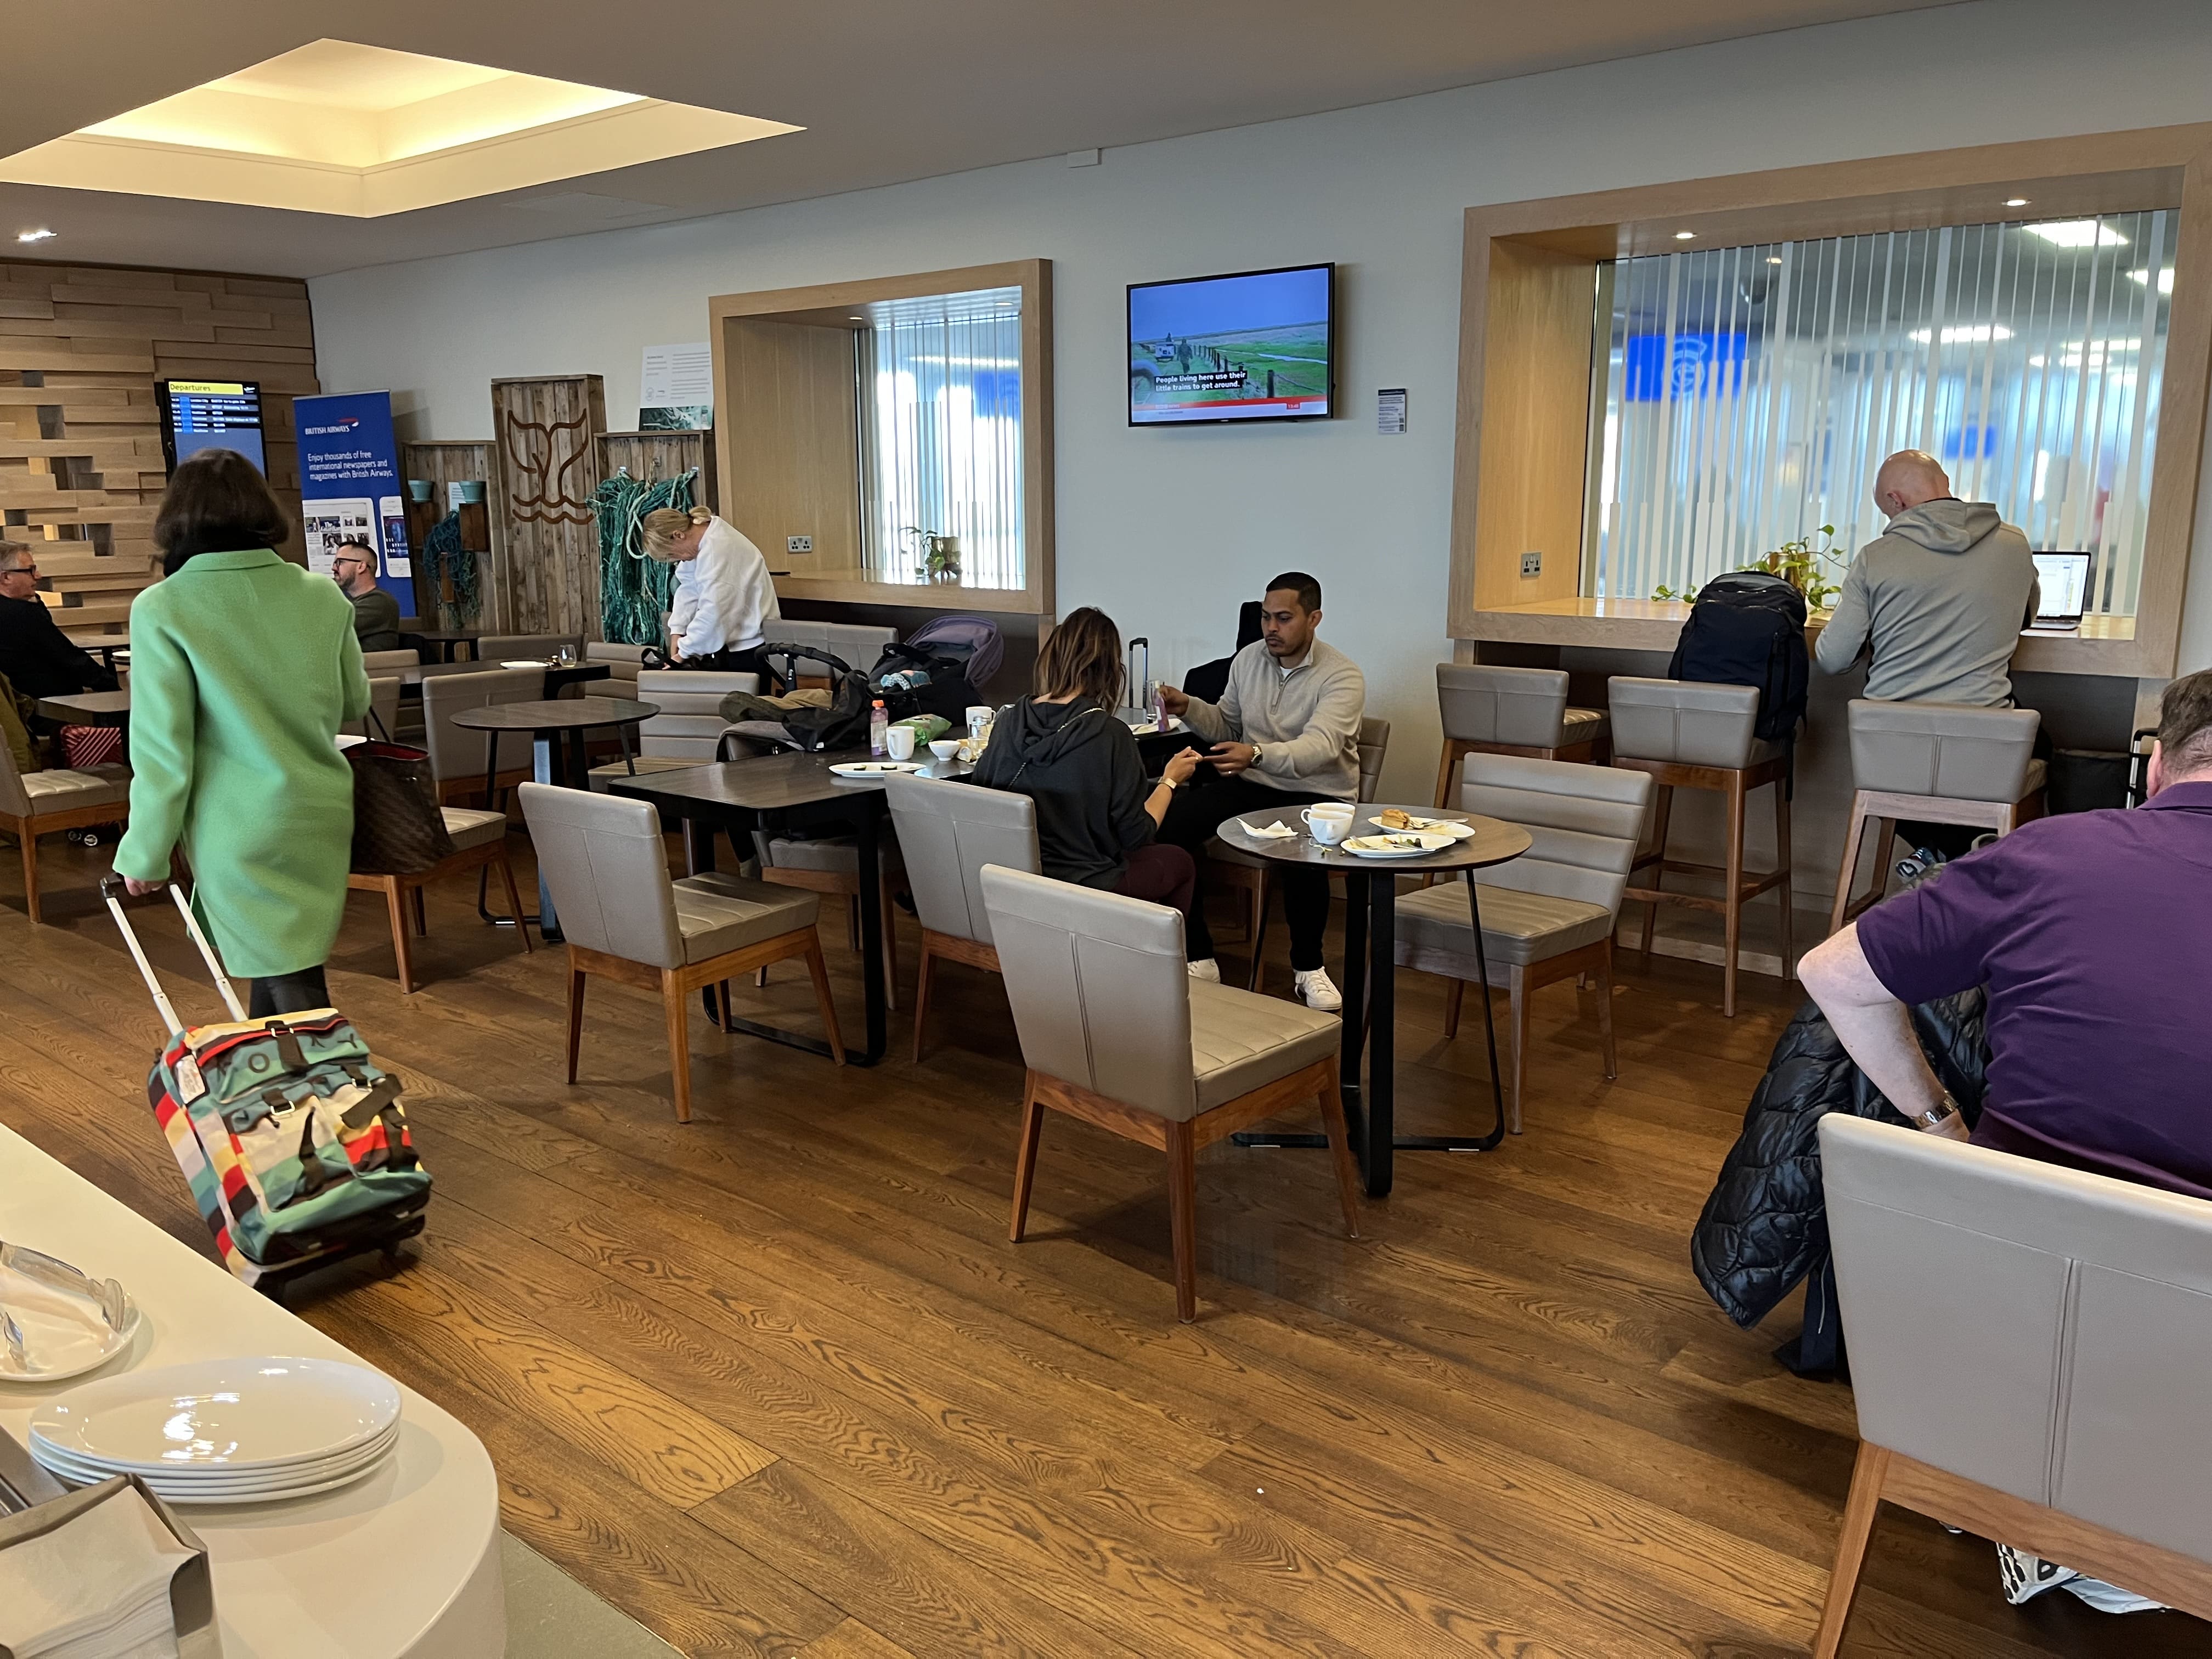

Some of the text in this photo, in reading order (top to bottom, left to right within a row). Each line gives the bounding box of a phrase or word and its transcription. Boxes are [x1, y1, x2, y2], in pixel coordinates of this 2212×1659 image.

[1180, 375, 1197, 383] living
[305, 425, 350, 435] BRITISH AIRWAYS
[308, 454, 324, 462] Enjoy
[324, 452, 352, 460] thousands
[309, 462, 342, 470] international
[343, 461, 376, 469] newspapers
[310, 472, 337, 481] magazines
[352, 470, 369, 478] British
[370, 469, 394, 478] Airways.
